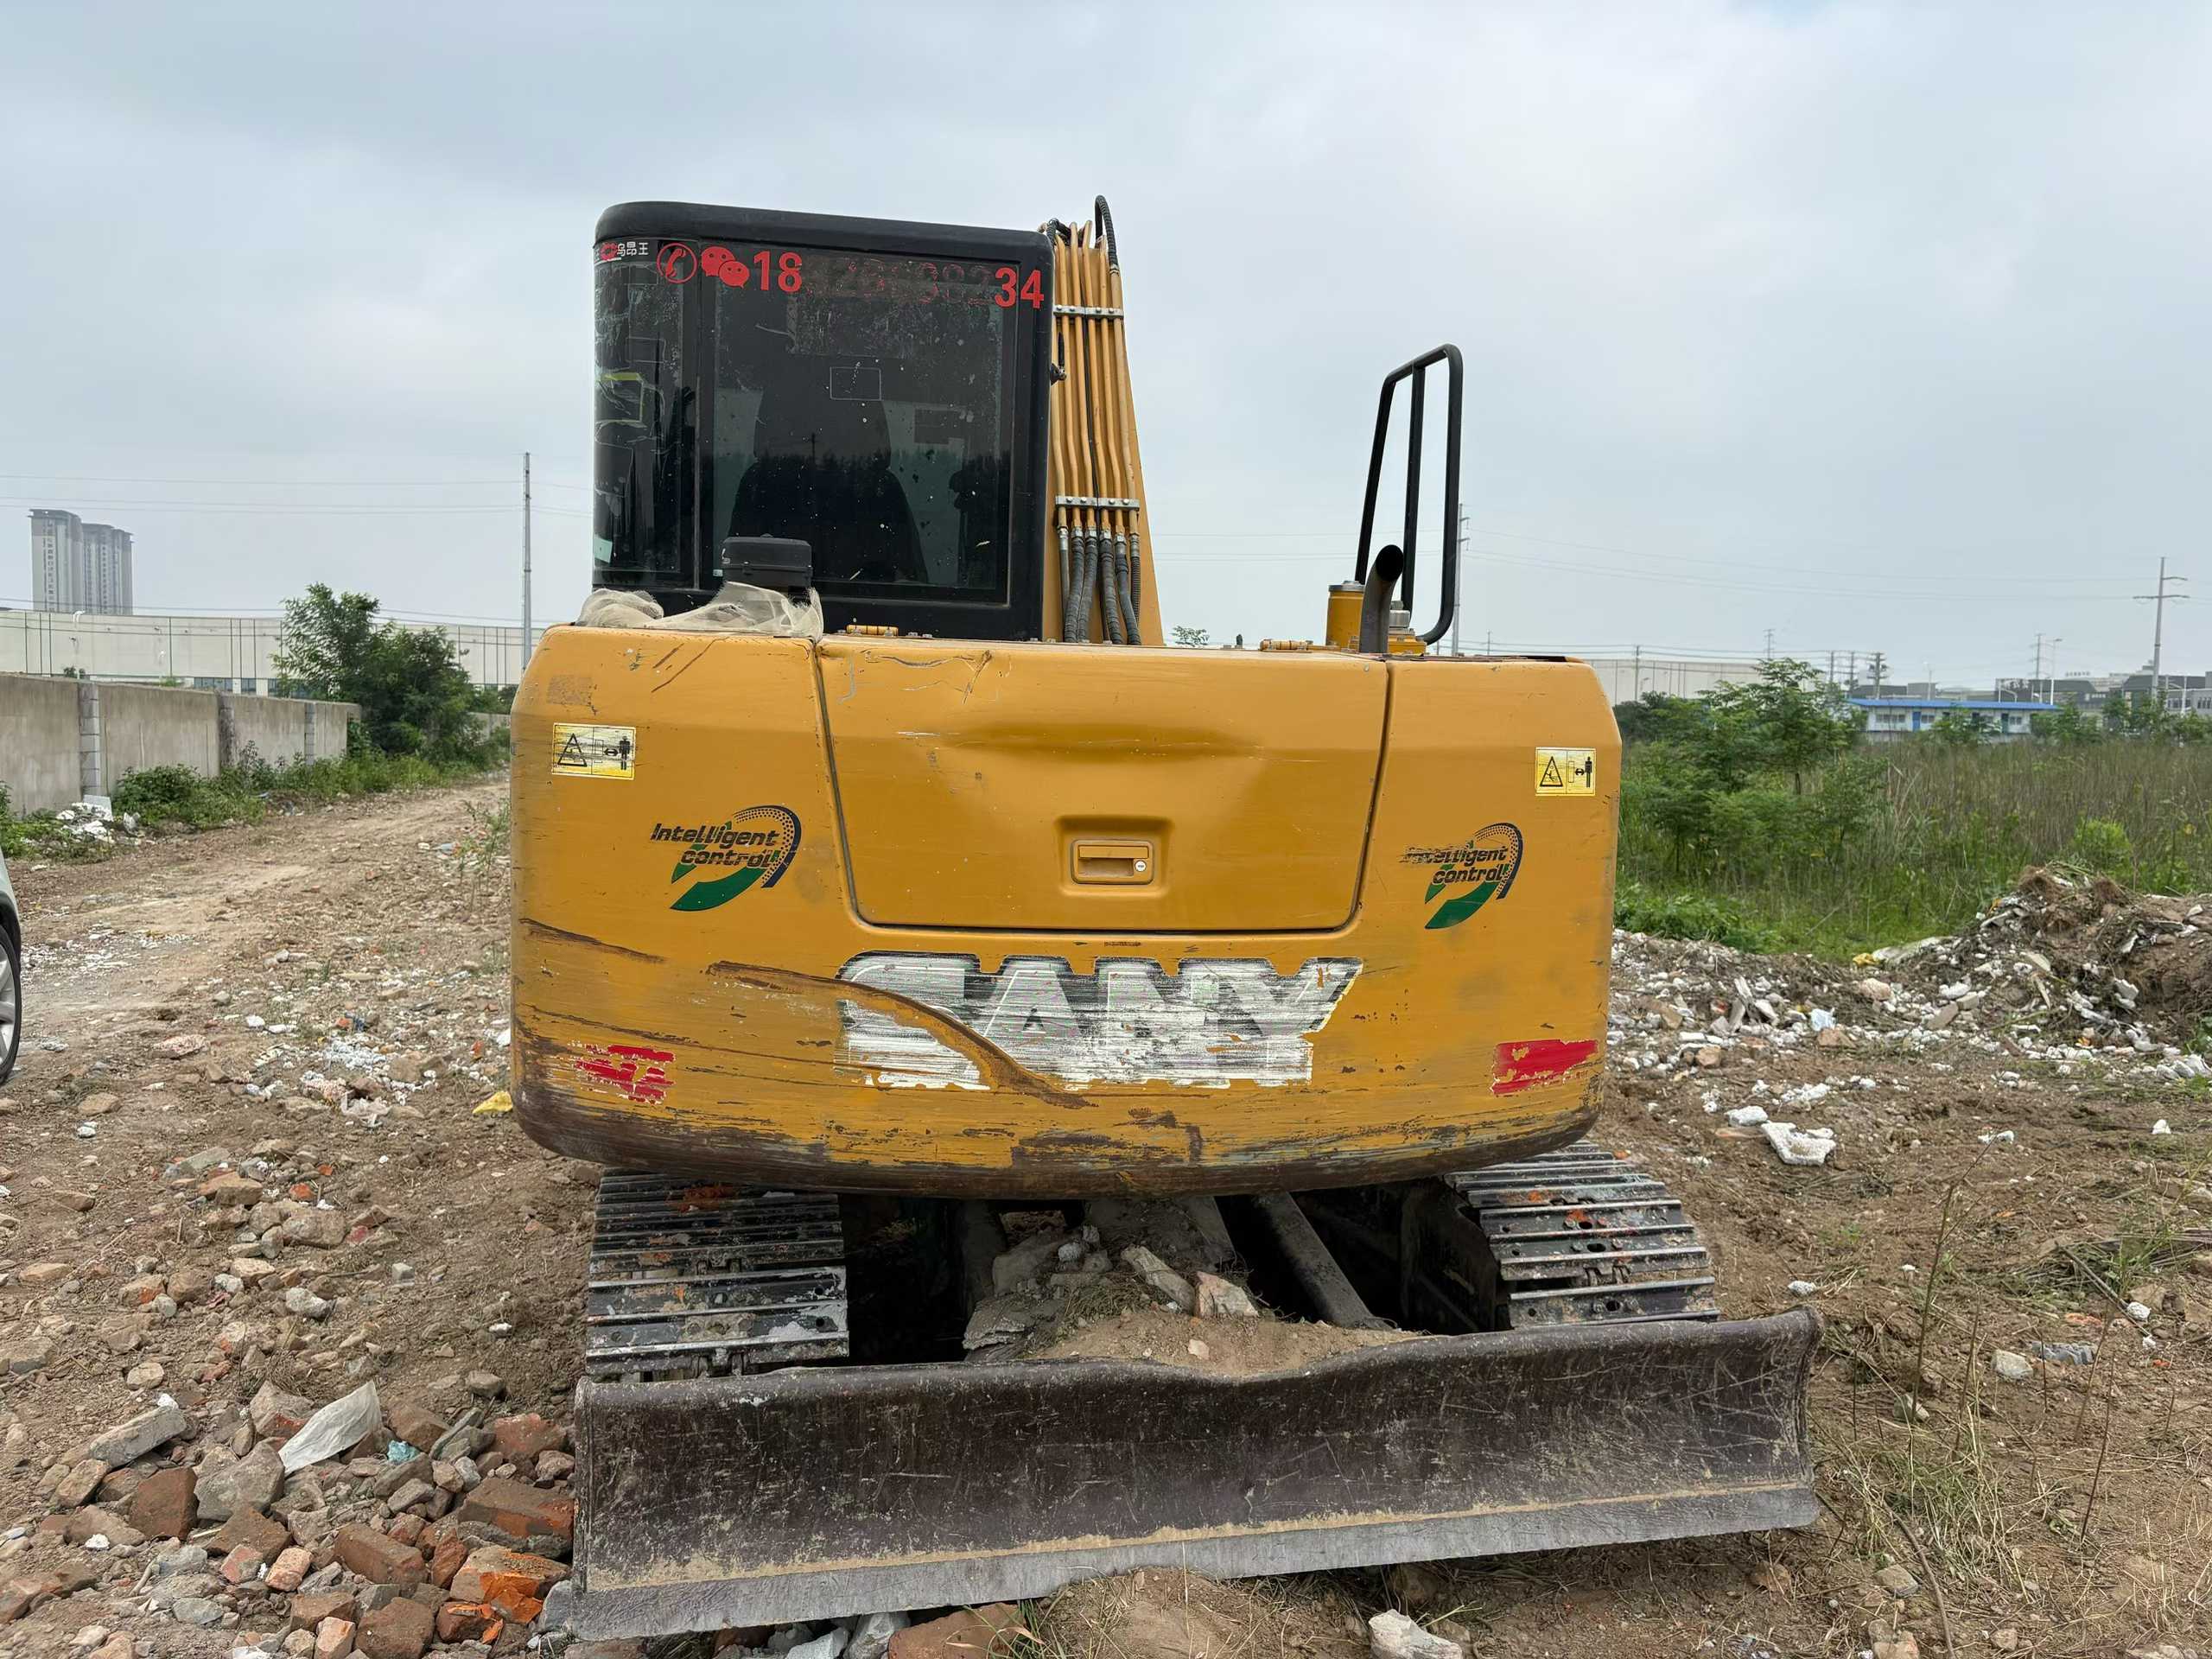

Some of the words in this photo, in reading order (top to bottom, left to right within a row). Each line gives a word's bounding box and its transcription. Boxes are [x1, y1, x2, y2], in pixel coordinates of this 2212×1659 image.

[650, 823, 780, 849] Intelligent
[680, 849, 774, 868] control
[1433, 864, 1504, 884] control
